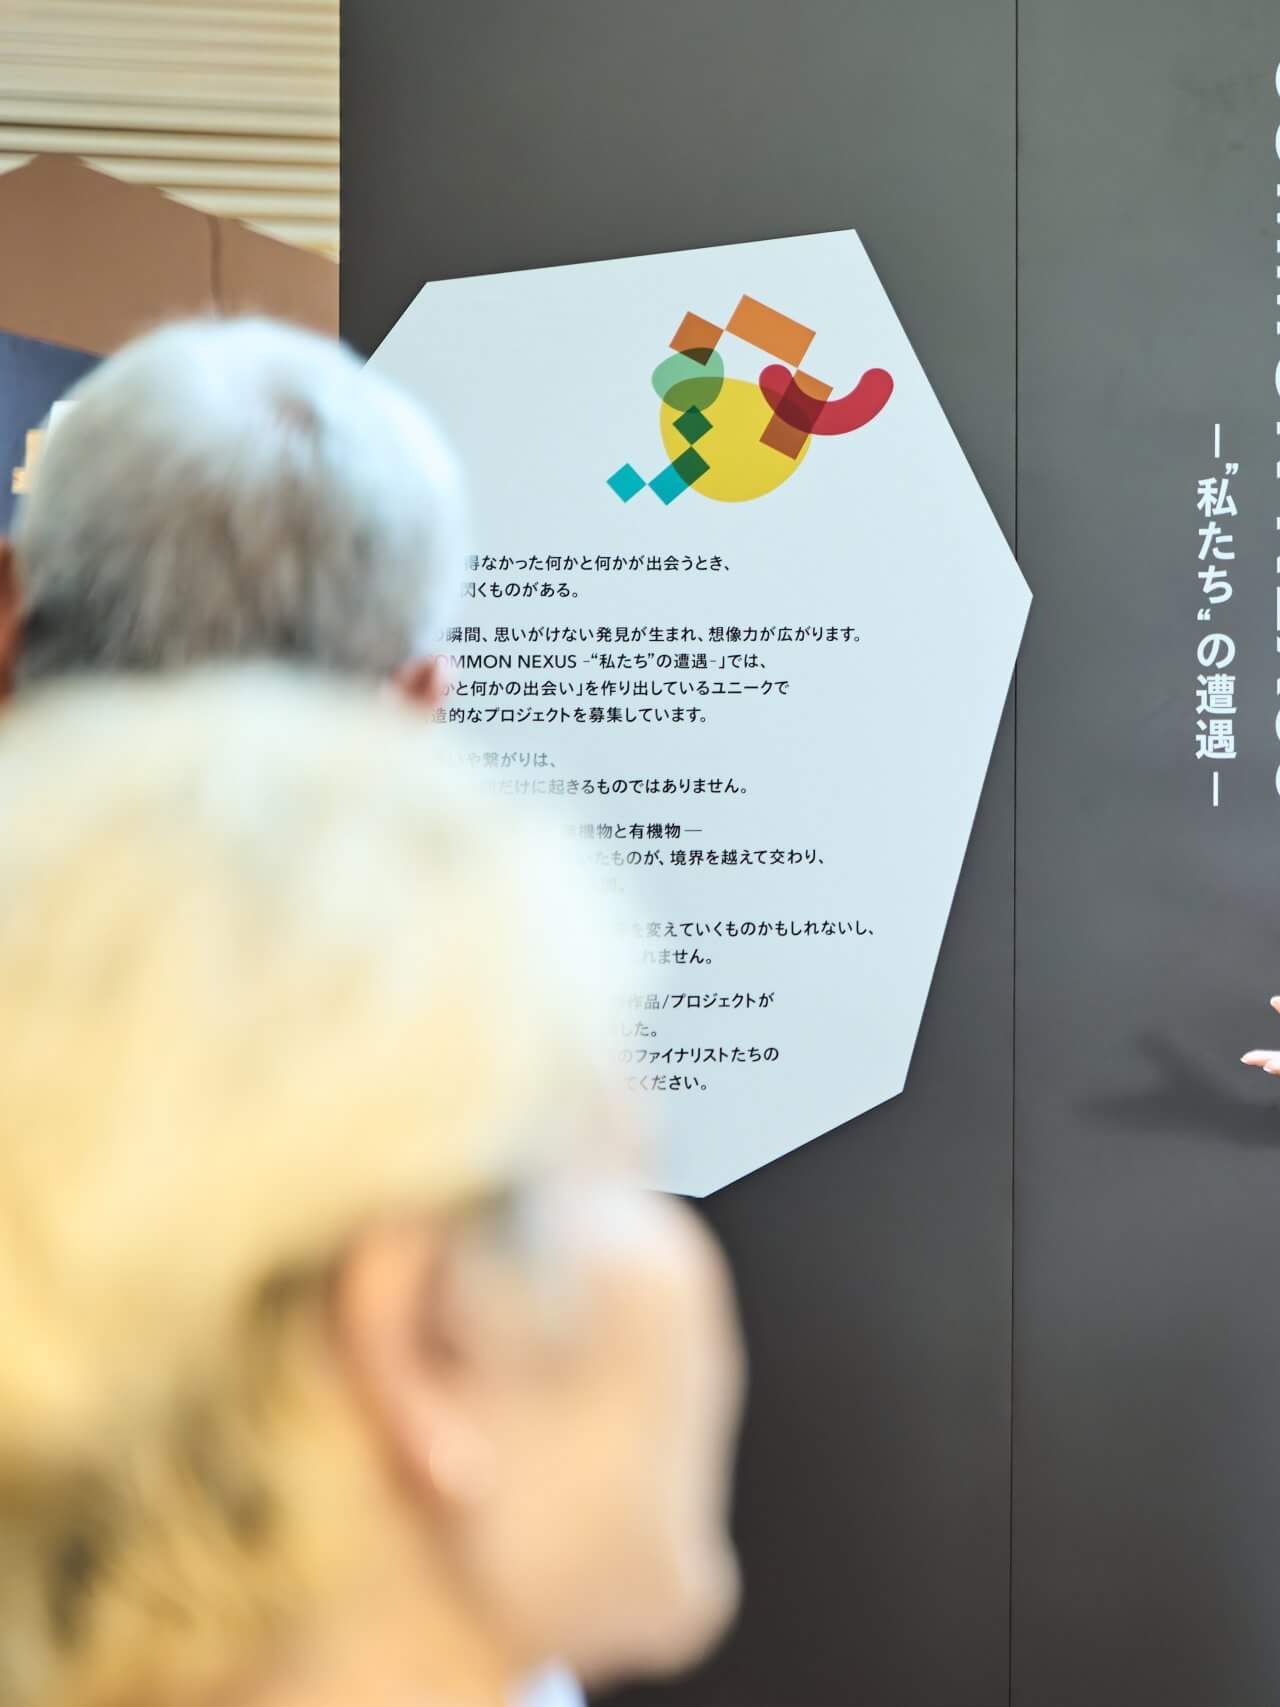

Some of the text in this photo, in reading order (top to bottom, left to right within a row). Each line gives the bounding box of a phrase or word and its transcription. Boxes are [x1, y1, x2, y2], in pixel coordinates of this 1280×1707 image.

[434, 654, 512, 669] OMMON
[518, 654, 577, 669] NEXUS
[490, 778, 747, 795] だけに起きるものではありません。
[594, 848, 825, 866] たものが、境界を越えて交わり、
